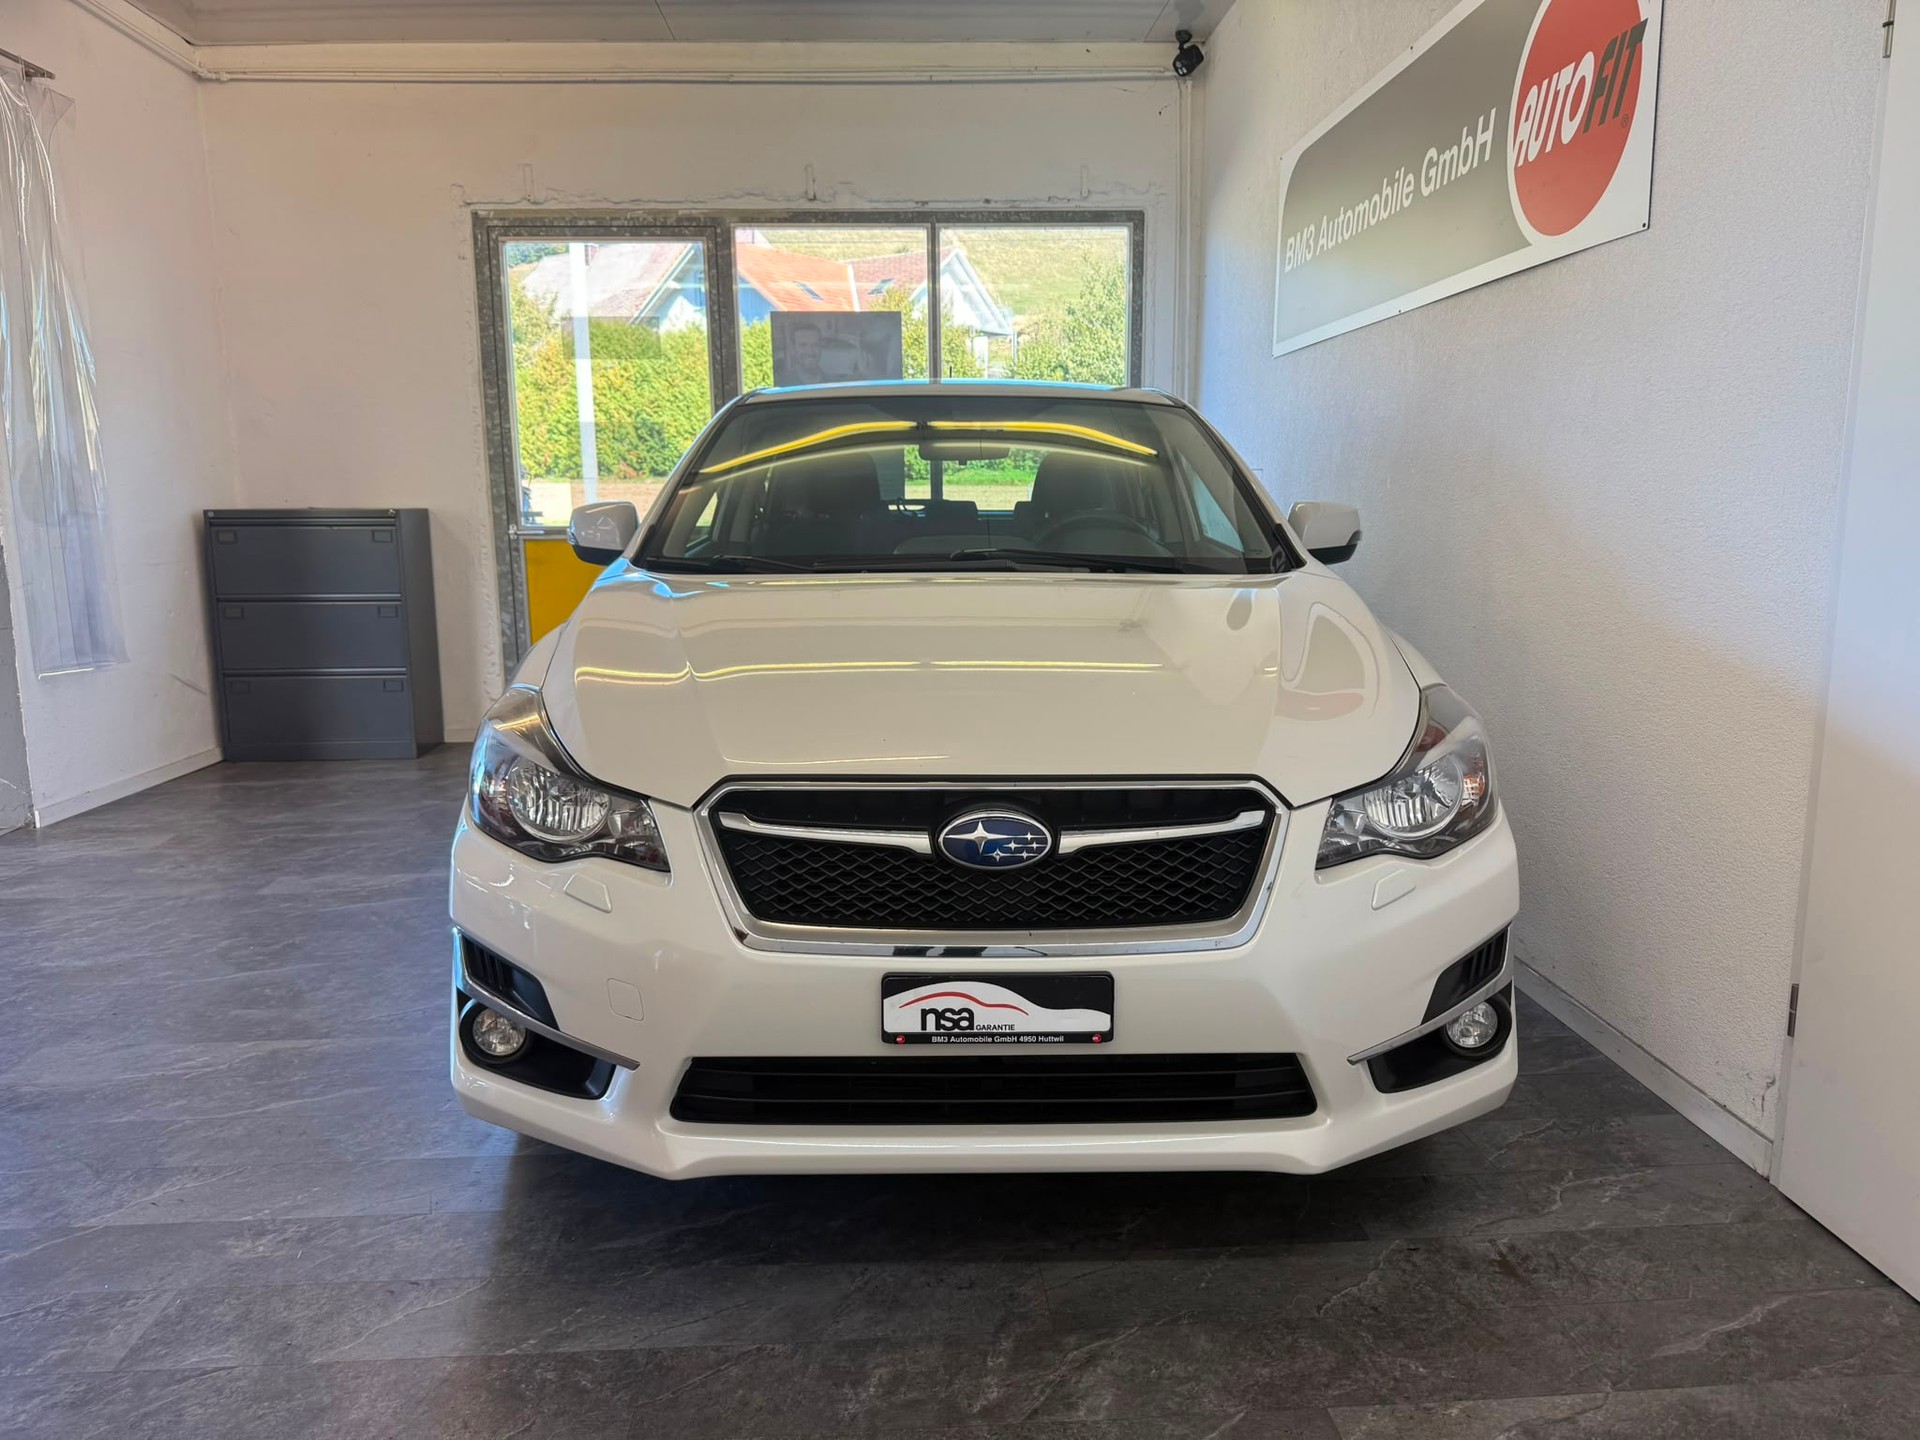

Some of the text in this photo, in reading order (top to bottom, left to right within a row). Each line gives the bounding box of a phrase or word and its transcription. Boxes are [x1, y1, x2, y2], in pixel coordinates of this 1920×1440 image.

[1513, 18, 1648, 168] AUTOFIT
[1285, 107, 1496, 274] BM3 Automobile GmbH
[921, 1007, 974, 1031] nsa
[950, 1035, 992, 1043] Automobile
[994, 1035, 1017, 1043] GmbH
[1019, 1035, 1037, 1043] 4950
